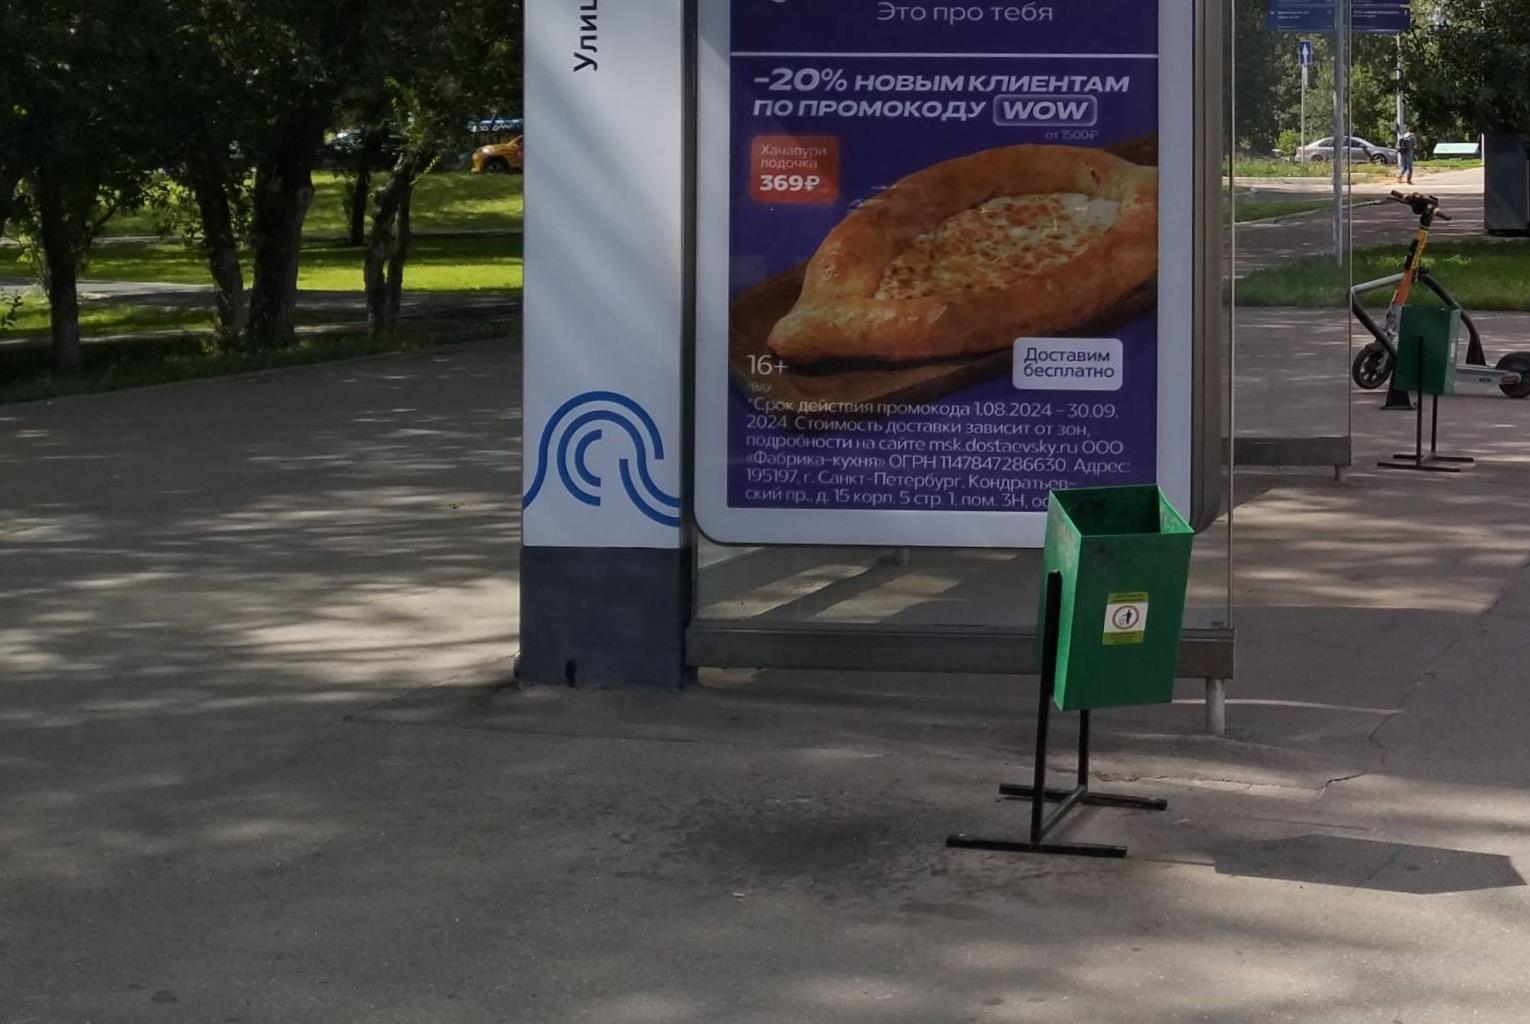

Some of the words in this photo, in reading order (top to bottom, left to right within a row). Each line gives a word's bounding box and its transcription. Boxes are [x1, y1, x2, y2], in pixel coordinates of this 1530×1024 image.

[877, 2, 927, 22] Это
[934, 5, 984, 25] про
[990, 2, 1054, 22] тебя
[753, 68, 848, 93] -20%
[854, 74, 964, 93] НОВЫМ
[967, 74, 1131, 94] КЛИЕНТАМ
[752, 99, 794, 117] ПО
[797, 100, 987, 122] ПРОМОКОДУ
[1002, 101, 1090, 121] WOW
[1045, 131, 1059, 141] от
[760, 144, 828, 159] Хачапури
[747, 354, 789, 376] 16+
[1024, 347, 1111, 364] Доставим
[1024, 363, 1115, 378] бесплатно
[797, 398, 874, 415] действия
[877, 402, 970, 418] промокода
[974, 401, 1053, 417] 1.08.2024
[1068, 403, 1119, 419] 30.09.
[794, 415, 883, 432] Стоимость
[884, 421, 961, 435] доставки
[965, 423, 1030, 435] зависит
[1034, 424, 1051, 436] от
[1057, 426, 1091, 437] зон,
[746, 434, 853, 451] подробности
[856, 439, 875, 450] на
[878, 437, 926, 451] сайте
[929, 437, 1078, 457] msk.dostaevsky.ru
[1082, 440, 1124, 455] ООО
[745, 450, 886, 470] «Фабрика-кухня»
[889, 454, 936, 469] ОГРН
[1073, 458, 1131, 476] Адрес:
[745, 487, 783, 501] ский
[833, 488, 850, 503] 15
[853, 492, 896, 506] корп.
[899, 490, 911, 504] 5
